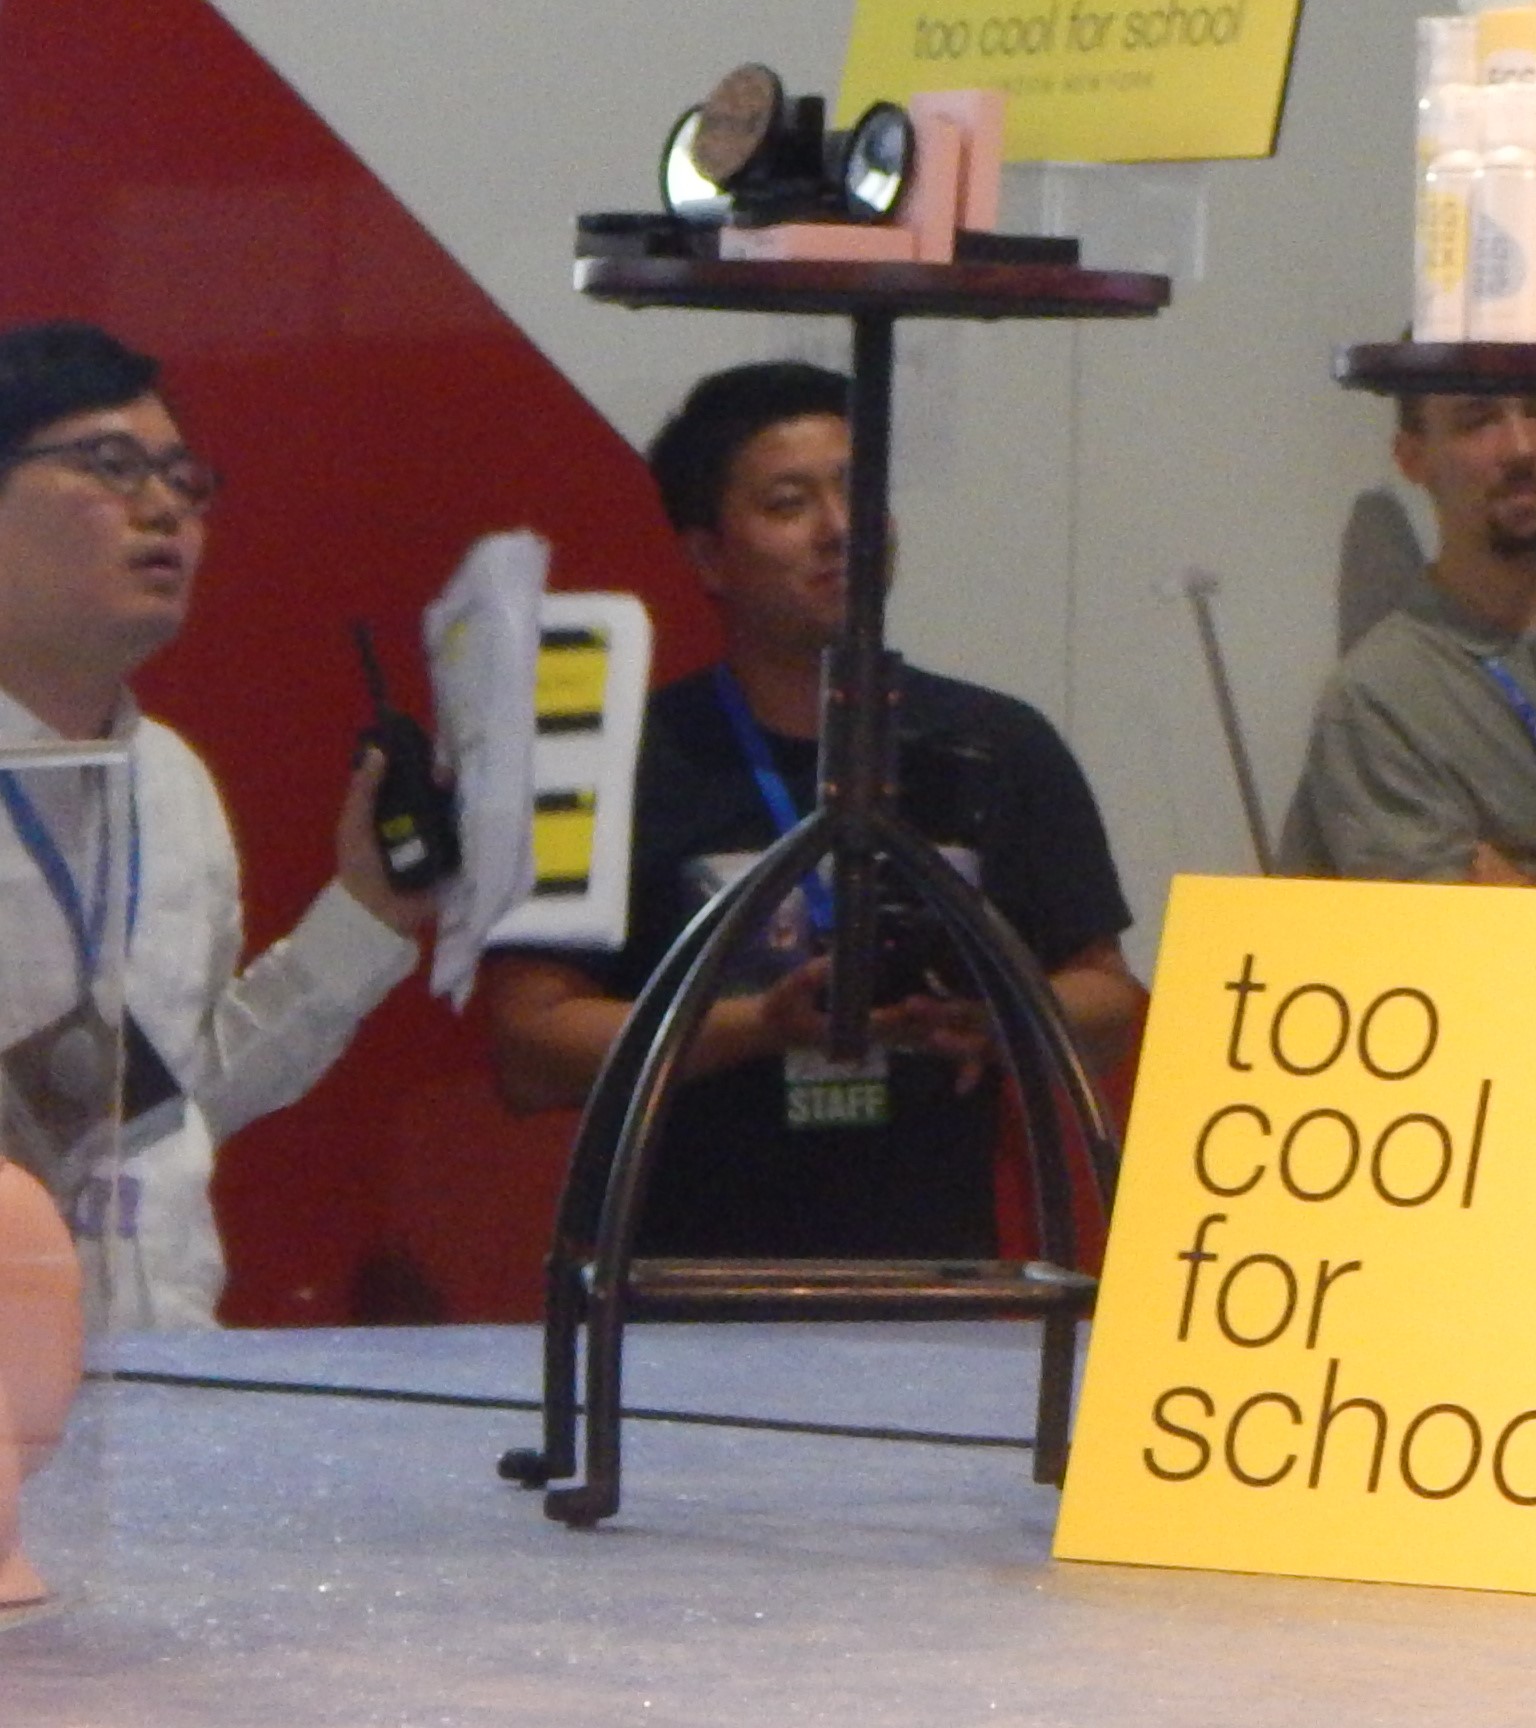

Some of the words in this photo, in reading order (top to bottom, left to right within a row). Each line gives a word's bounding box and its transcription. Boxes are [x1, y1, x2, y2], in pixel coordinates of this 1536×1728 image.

[912, 12, 971, 60] too
[980, 0, 1060, 57] cool
[1225, 953, 1440, 1082] too
[787, 1083, 884, 1123] STAFF
[1194, 1078, 1493, 1209] cool
[1176, 1212, 1363, 1351] for
